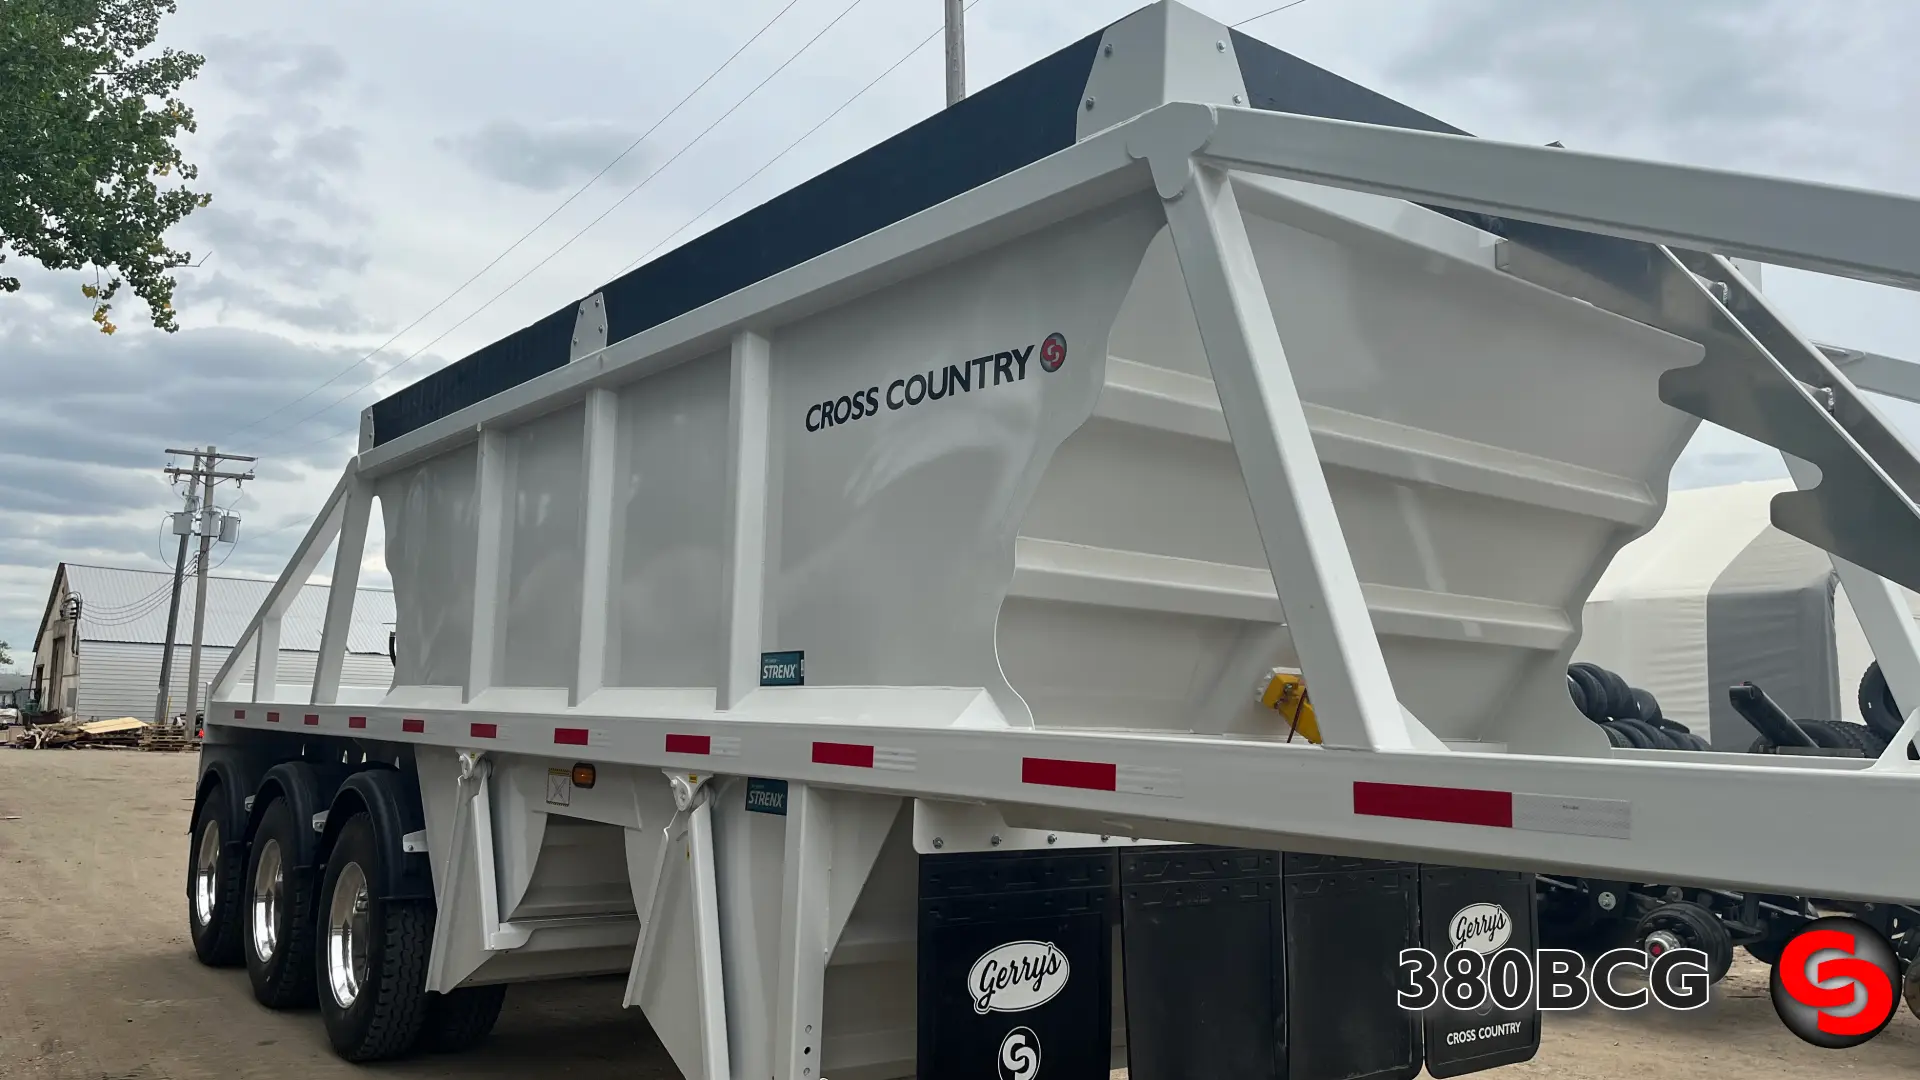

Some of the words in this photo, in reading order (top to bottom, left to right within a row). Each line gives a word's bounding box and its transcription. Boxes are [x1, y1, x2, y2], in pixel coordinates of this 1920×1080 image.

[805, 386, 879, 432] CROSS
[886, 344, 1036, 411] COUNTRY
[763, 664, 796, 679] STRENX
[749, 790, 784, 808] STRENX
[1456, 907, 1507, 949] Gerry's
[978, 945, 1062, 1009] Gerry's
[1446, 1029, 1476, 1046] CROSS
[1478, 1021, 1522, 1040] COUNTRY
